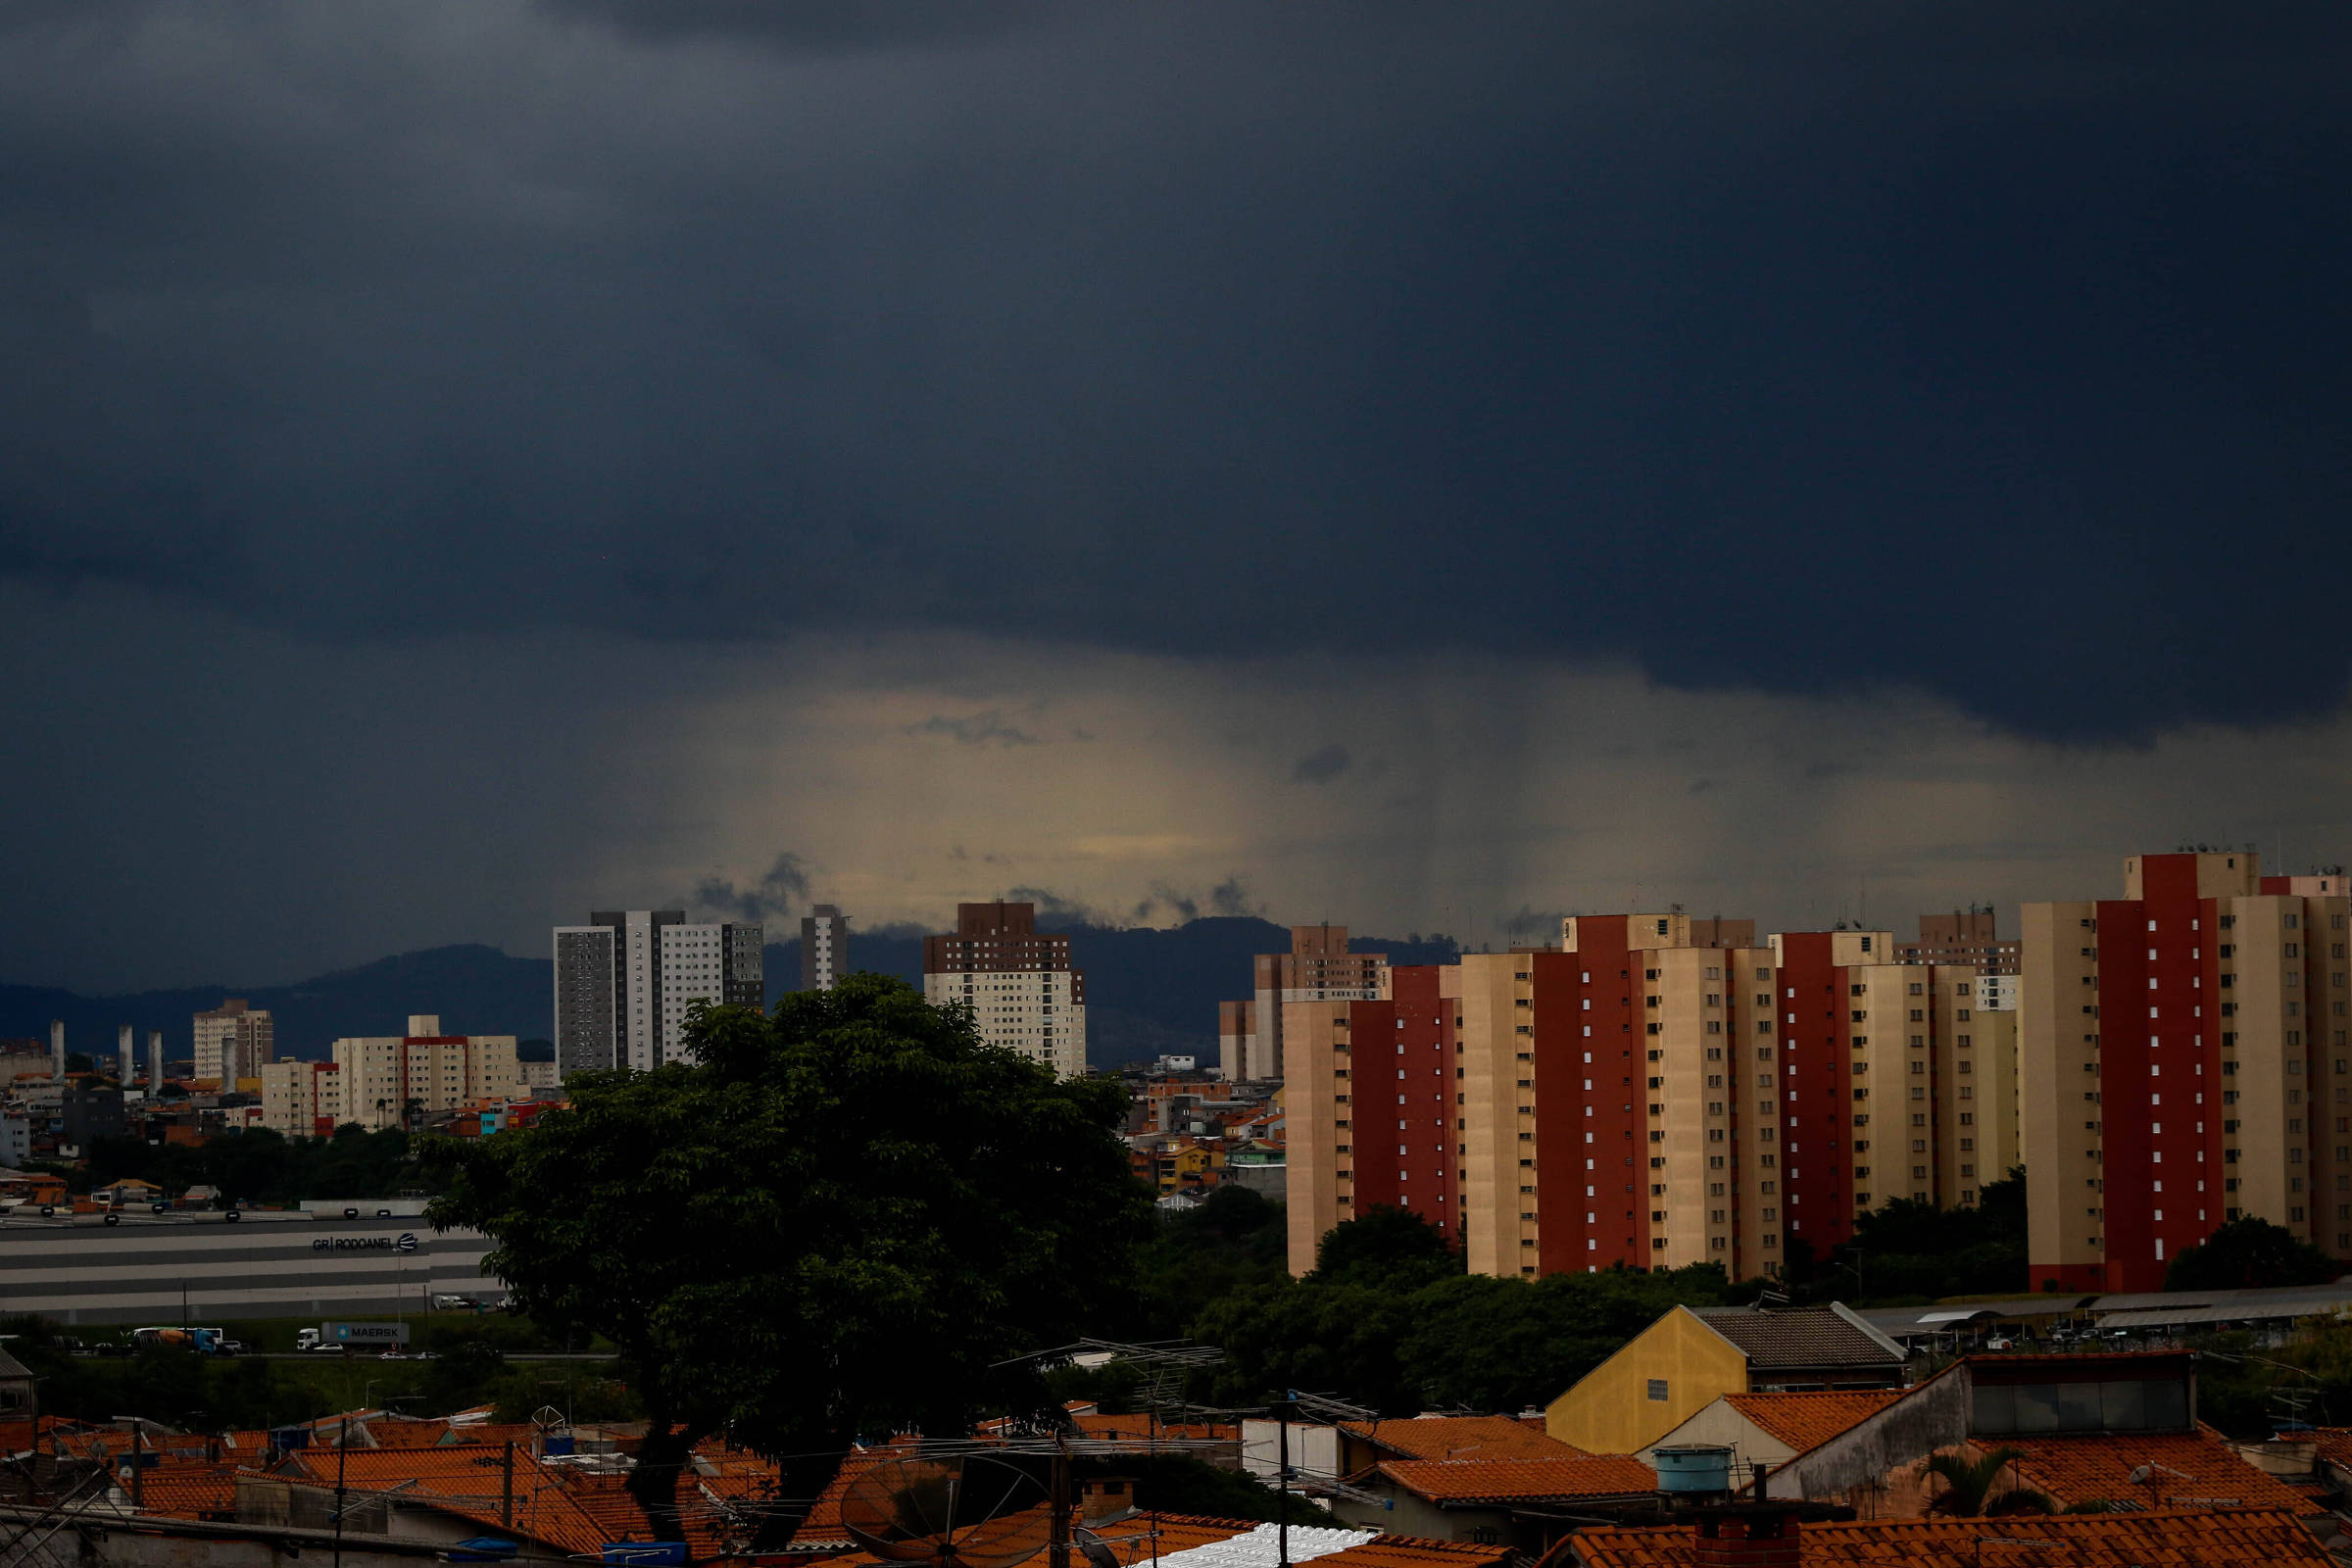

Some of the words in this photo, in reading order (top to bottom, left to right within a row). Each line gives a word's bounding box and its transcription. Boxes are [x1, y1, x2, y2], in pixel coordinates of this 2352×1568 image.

[313, 1239, 329, 1250] GR
[335, 1238, 393, 1250] RODOANEL
[352, 1328, 398, 1338] MAERSK
